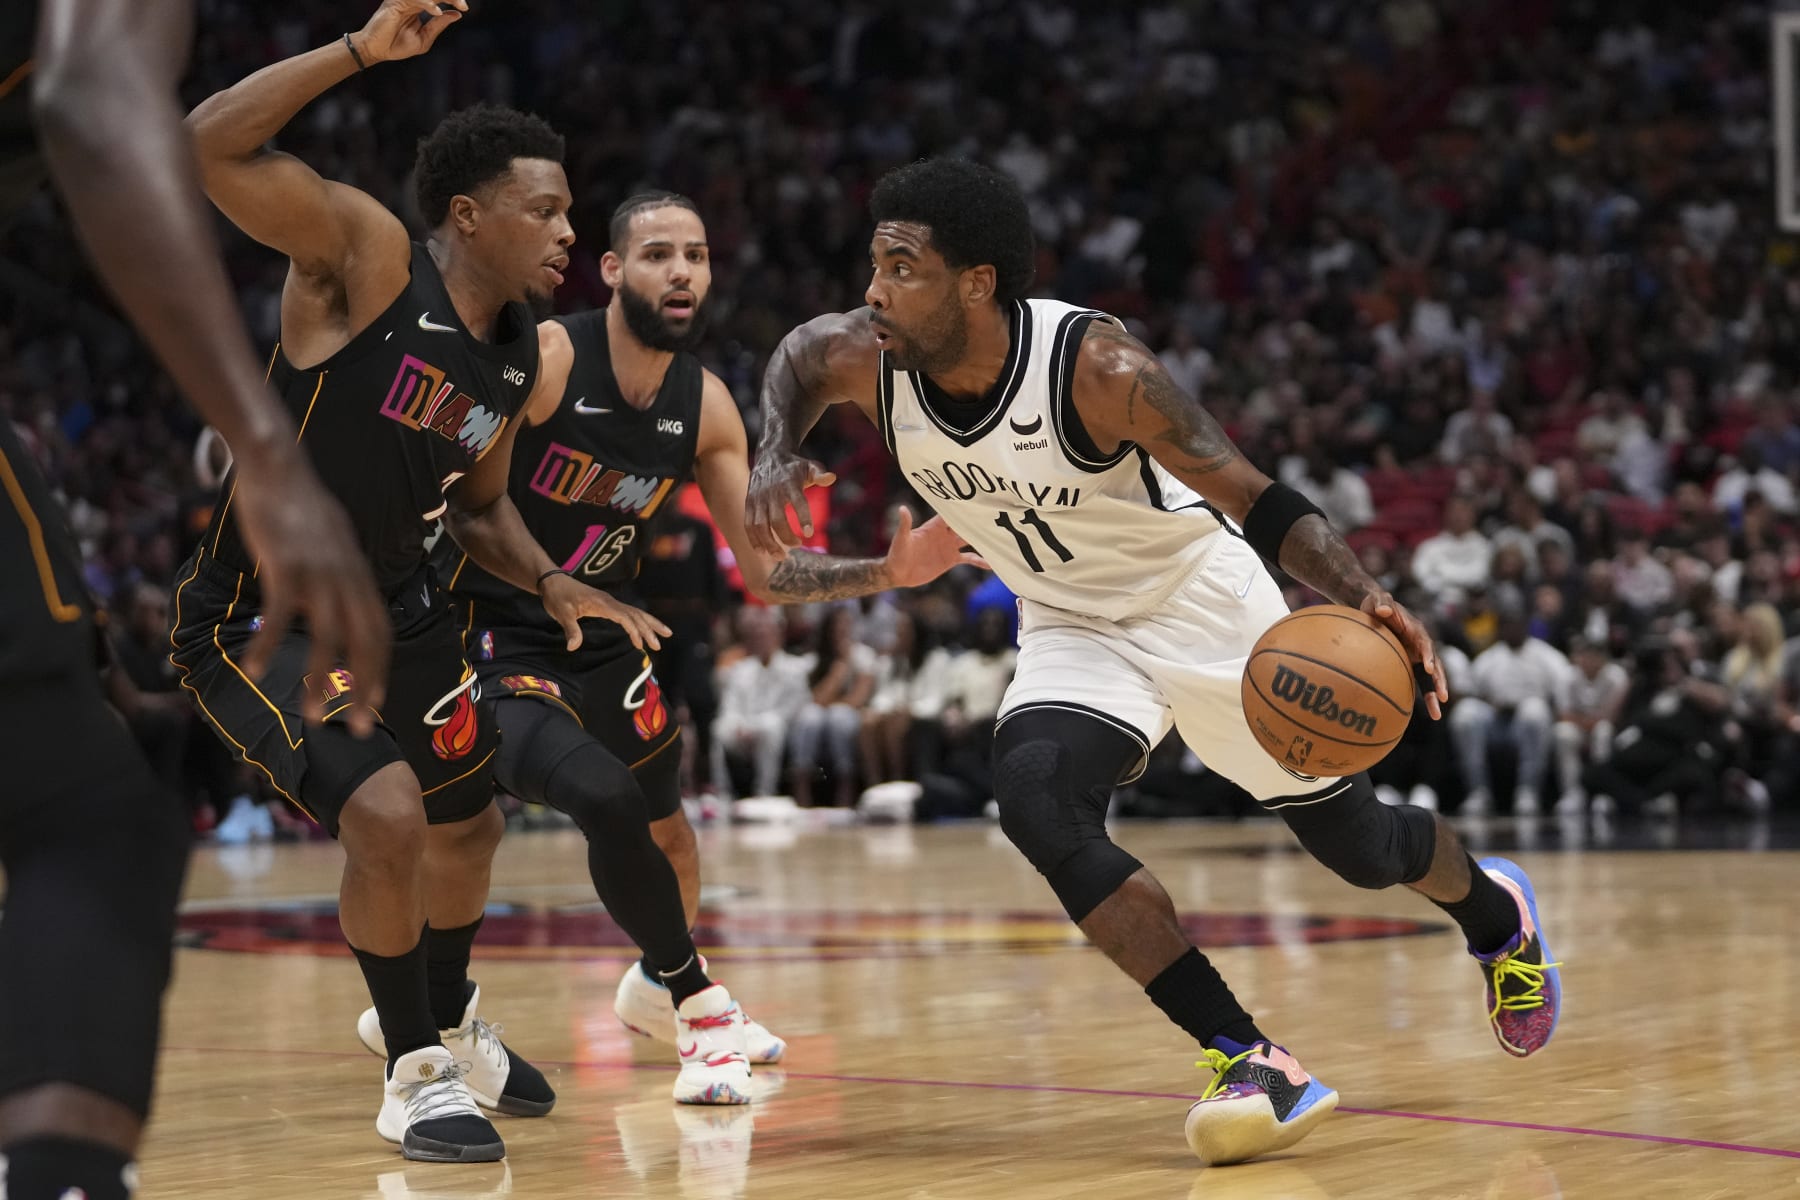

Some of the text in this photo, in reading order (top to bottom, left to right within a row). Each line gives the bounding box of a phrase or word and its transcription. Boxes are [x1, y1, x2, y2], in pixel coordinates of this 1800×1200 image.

[379, 353, 508, 462] MIAMI
[529, 441, 675, 519] MIAMI
[1013, 438, 1049, 452] Webull
[561, 524, 636, 575] 16
[994, 508, 1075, 573] 11
[1271, 662, 1378, 737] Wilson
